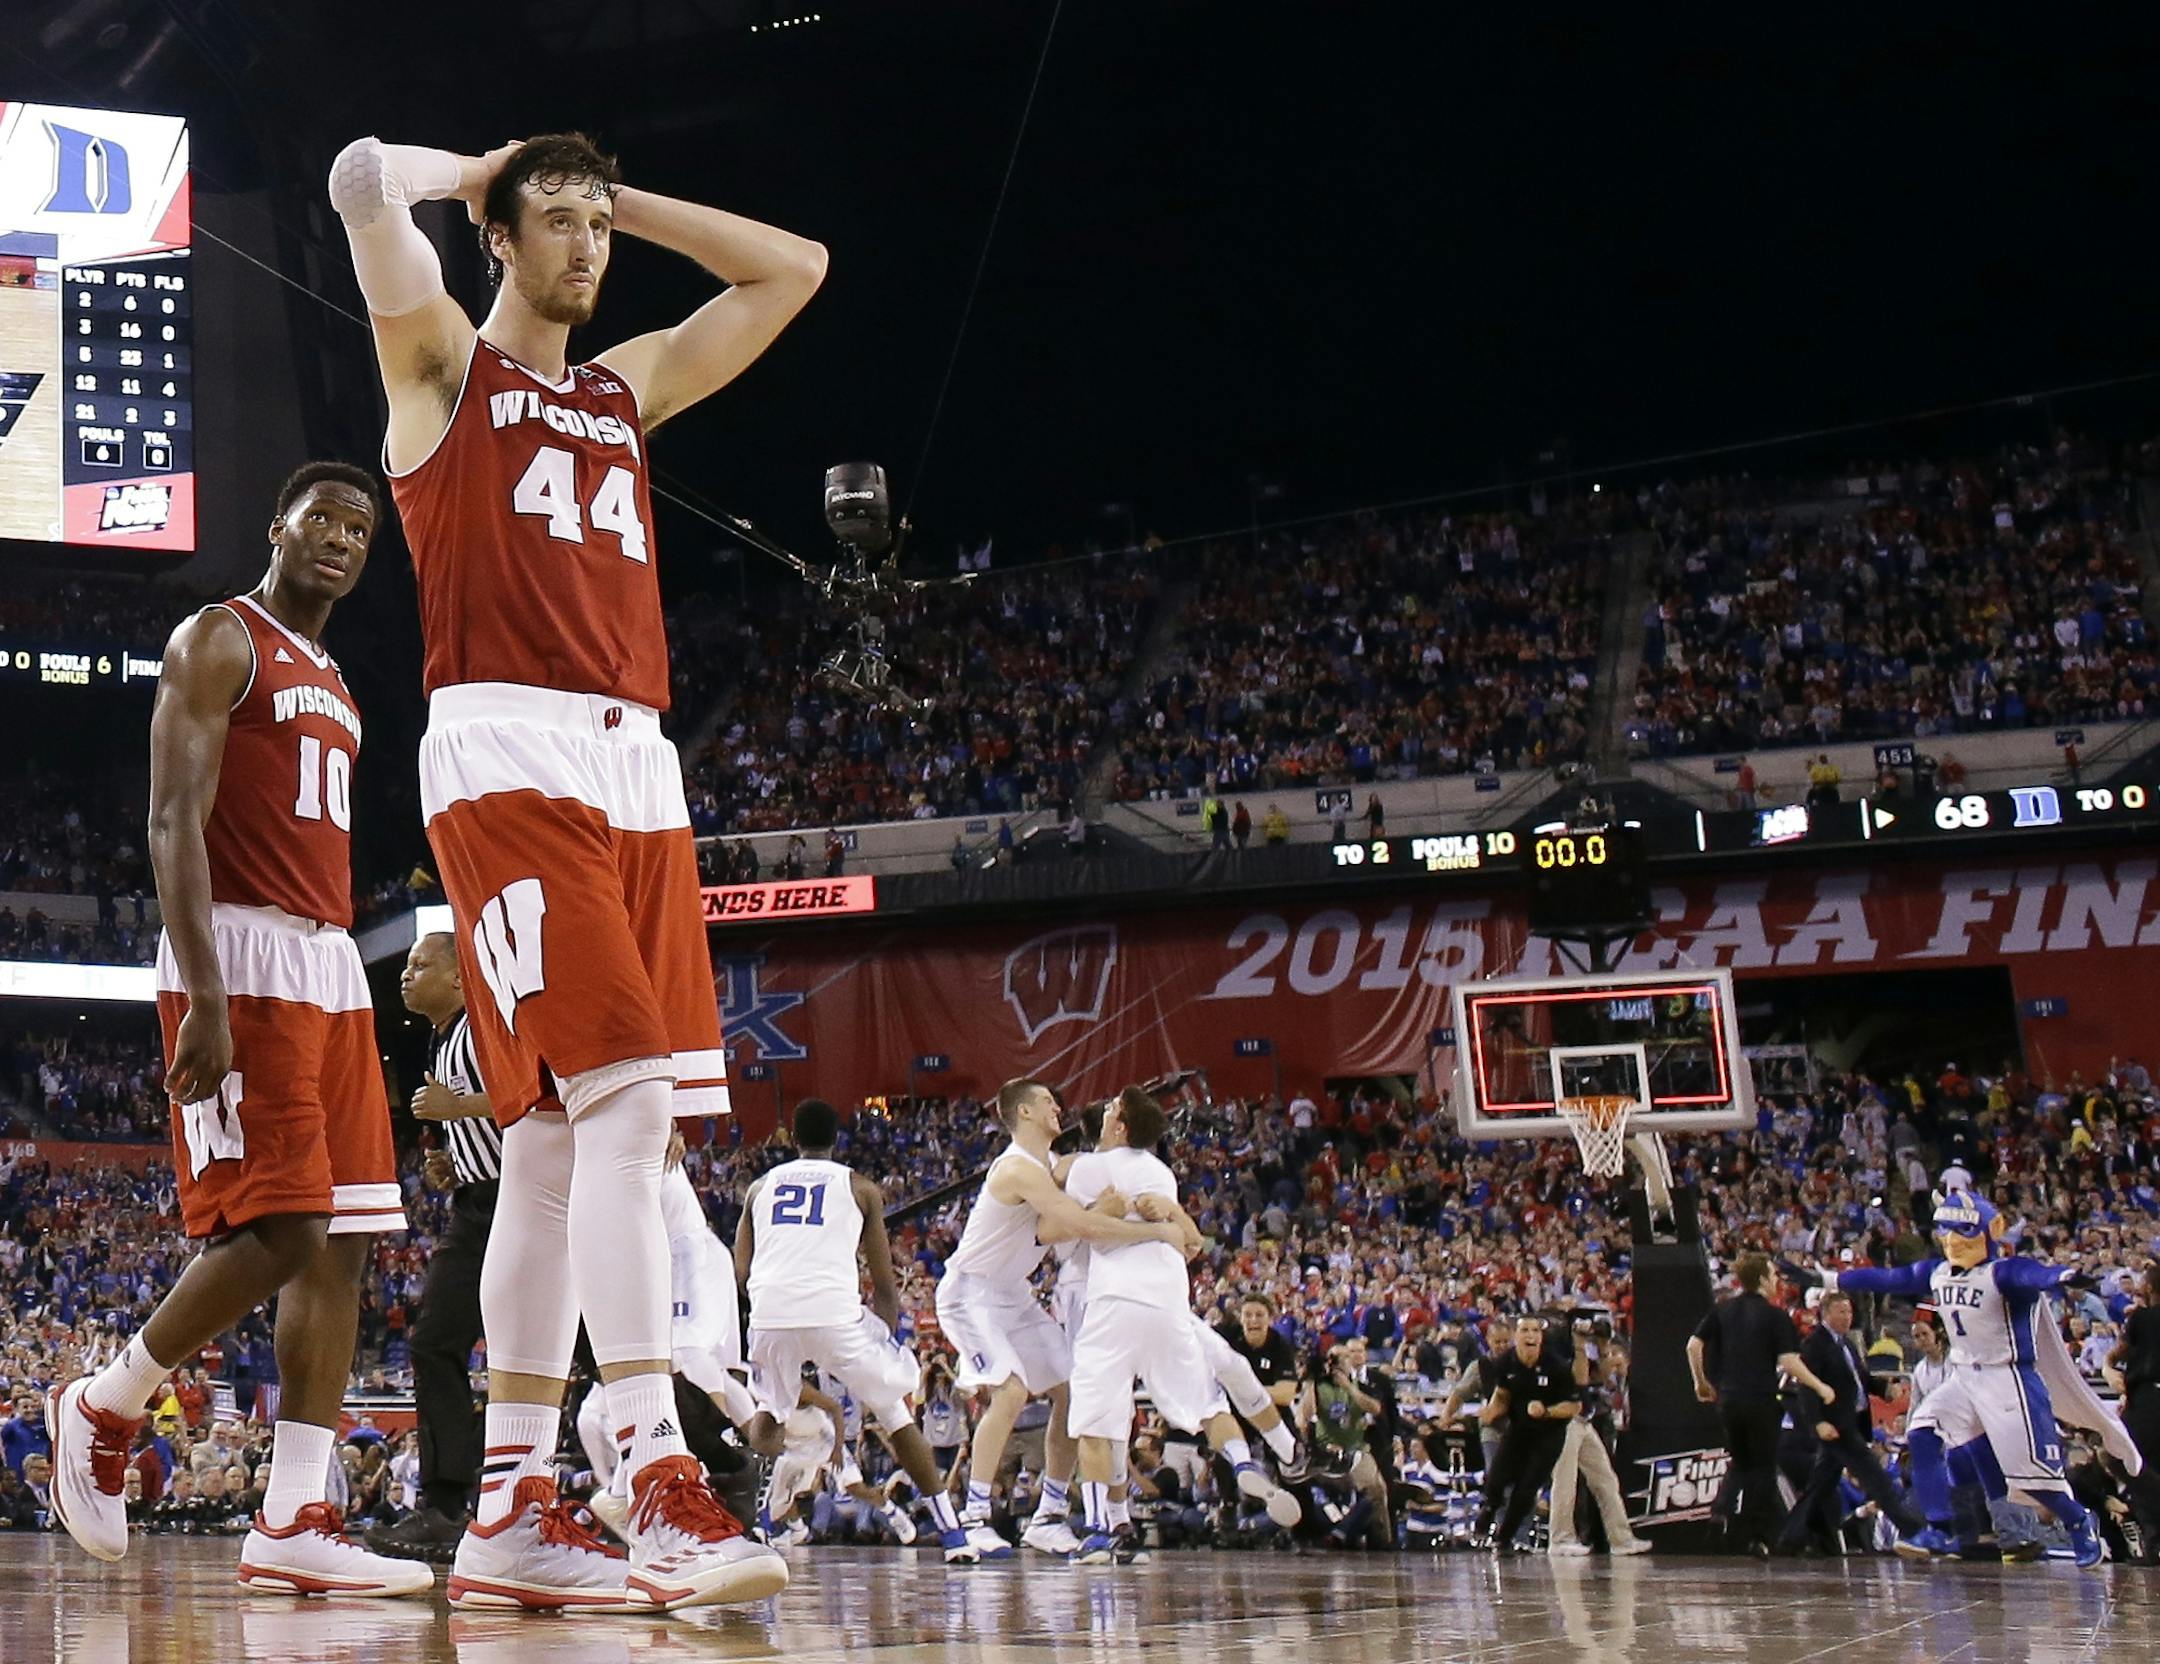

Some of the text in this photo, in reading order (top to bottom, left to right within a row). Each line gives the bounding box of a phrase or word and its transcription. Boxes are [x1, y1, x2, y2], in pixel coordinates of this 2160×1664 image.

[65, 268, 185, 291] PLYR PTS FLS
[79, 291, 175, 314] 2 6 0
[79, 318, 175, 341] 3 16 0
[162, 381, 176, 398] 4
[125, 407, 138, 423] 2
[78, 426, 125, 442] FOULS
[96, 445, 165, 465] 6 0
[513, 446, 647, 564] 44
[40, 653, 91, 672] FOULS
[97, 656, 112, 675] 6
[41, 670, 90, 685] BONUS
[1878, 748, 1913, 765] 453
[295, 735, 351, 833] 10
[1319, 793, 1350, 809] 42
[1934, 794, 1990, 830] 68
[2075, 788, 2114, 812] TO
[2122, 785, 2146, 809] 0
[1333, 831, 1516, 866] TO 2 FOULS 10
[1535, 835, 1607, 869] 00.0
[1426, 854, 1480, 872] BONUS
[701, 889, 766, 916] NDS
[1200, 899, 1493, 1000] 2015
[1897, 859, 2160, 960] FIN
[771, 1184, 826, 1226] 21
[1932, 1285, 1983, 1308] DUKE
[1951, 1309, 1967, 1336] 1
[1678, 1457, 1733, 1482] FINA
[1655, 1475, 1724, 1512] FOU
